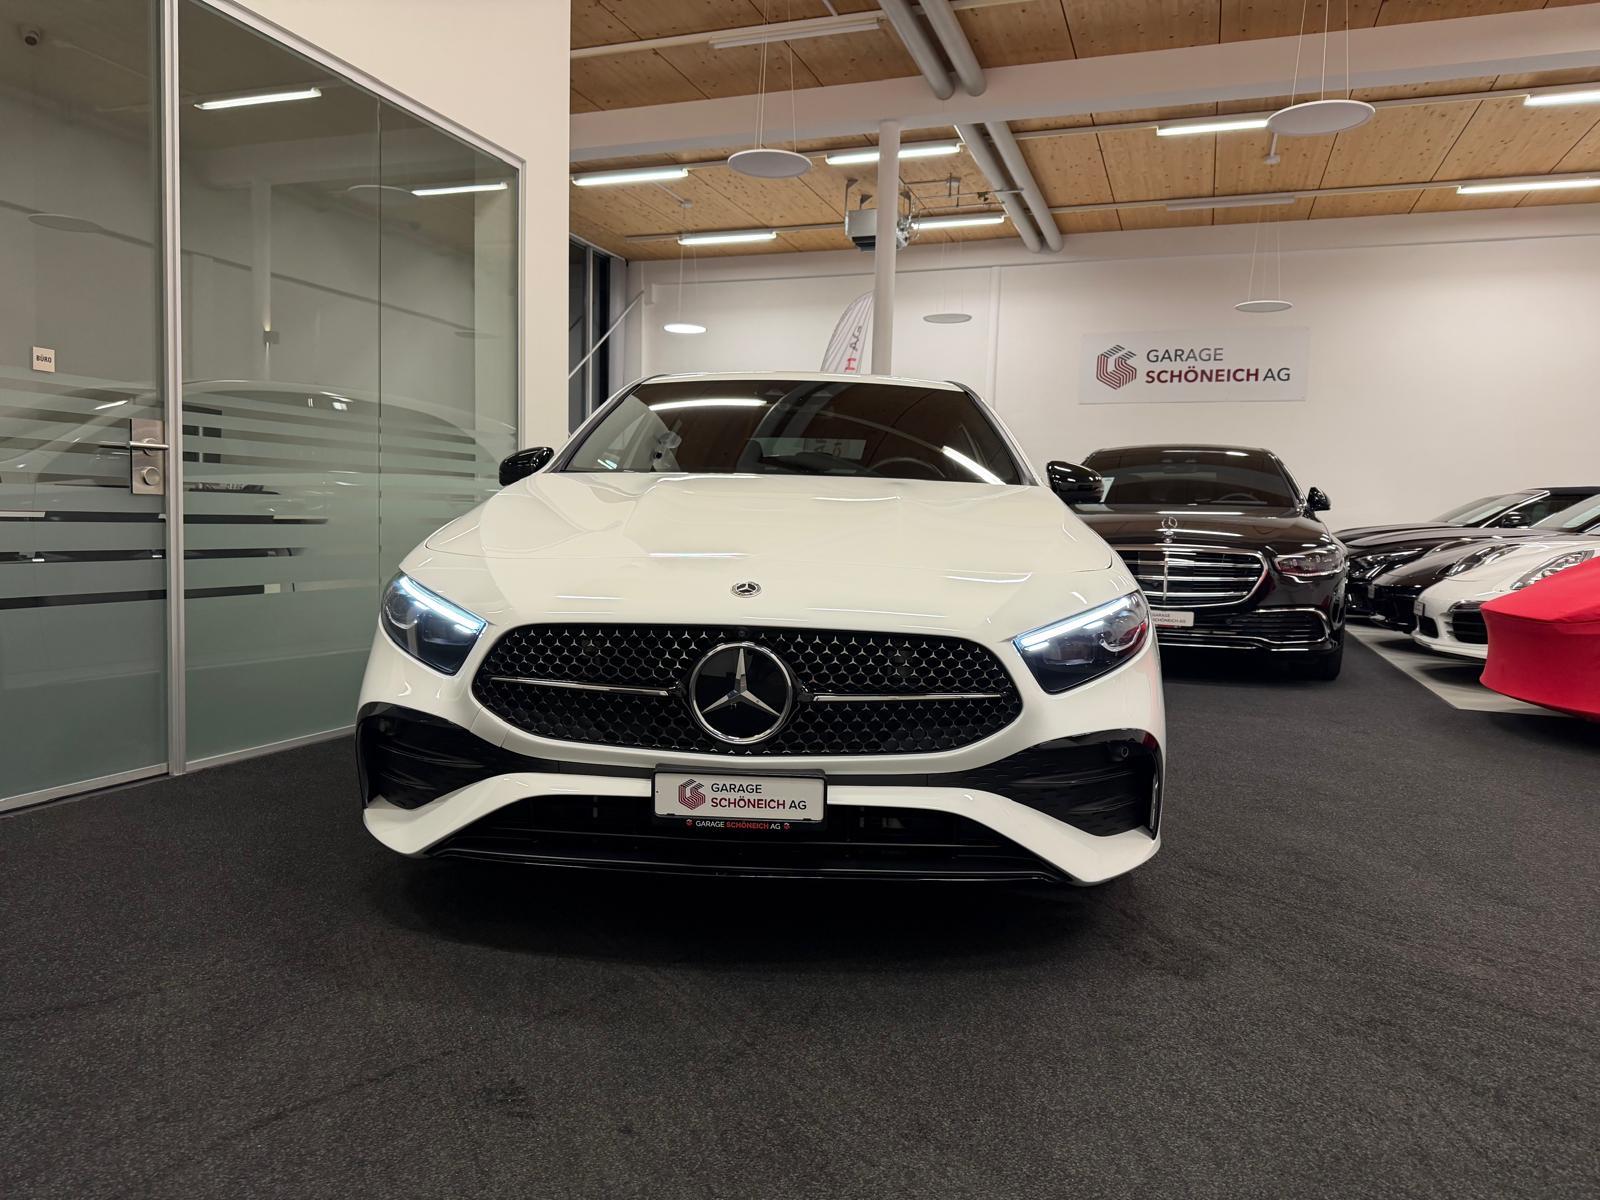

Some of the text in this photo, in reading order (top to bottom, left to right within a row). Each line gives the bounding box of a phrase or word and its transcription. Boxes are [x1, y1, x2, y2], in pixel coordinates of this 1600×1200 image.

[849, 325, 863, 352] AG
[36, 354, 52, 364] BÜRO
[1146, 347, 1224, 363] GARAGE
[1145, 366, 1291, 384] SCHÖNEICH AG
[710, 783, 762, 794] GARAGE
[710, 796, 807, 810] SCHÖNEICH AG
[695, 820, 725, 828] GARAGE
[726, 820, 769, 830] SCHÖNEICH
